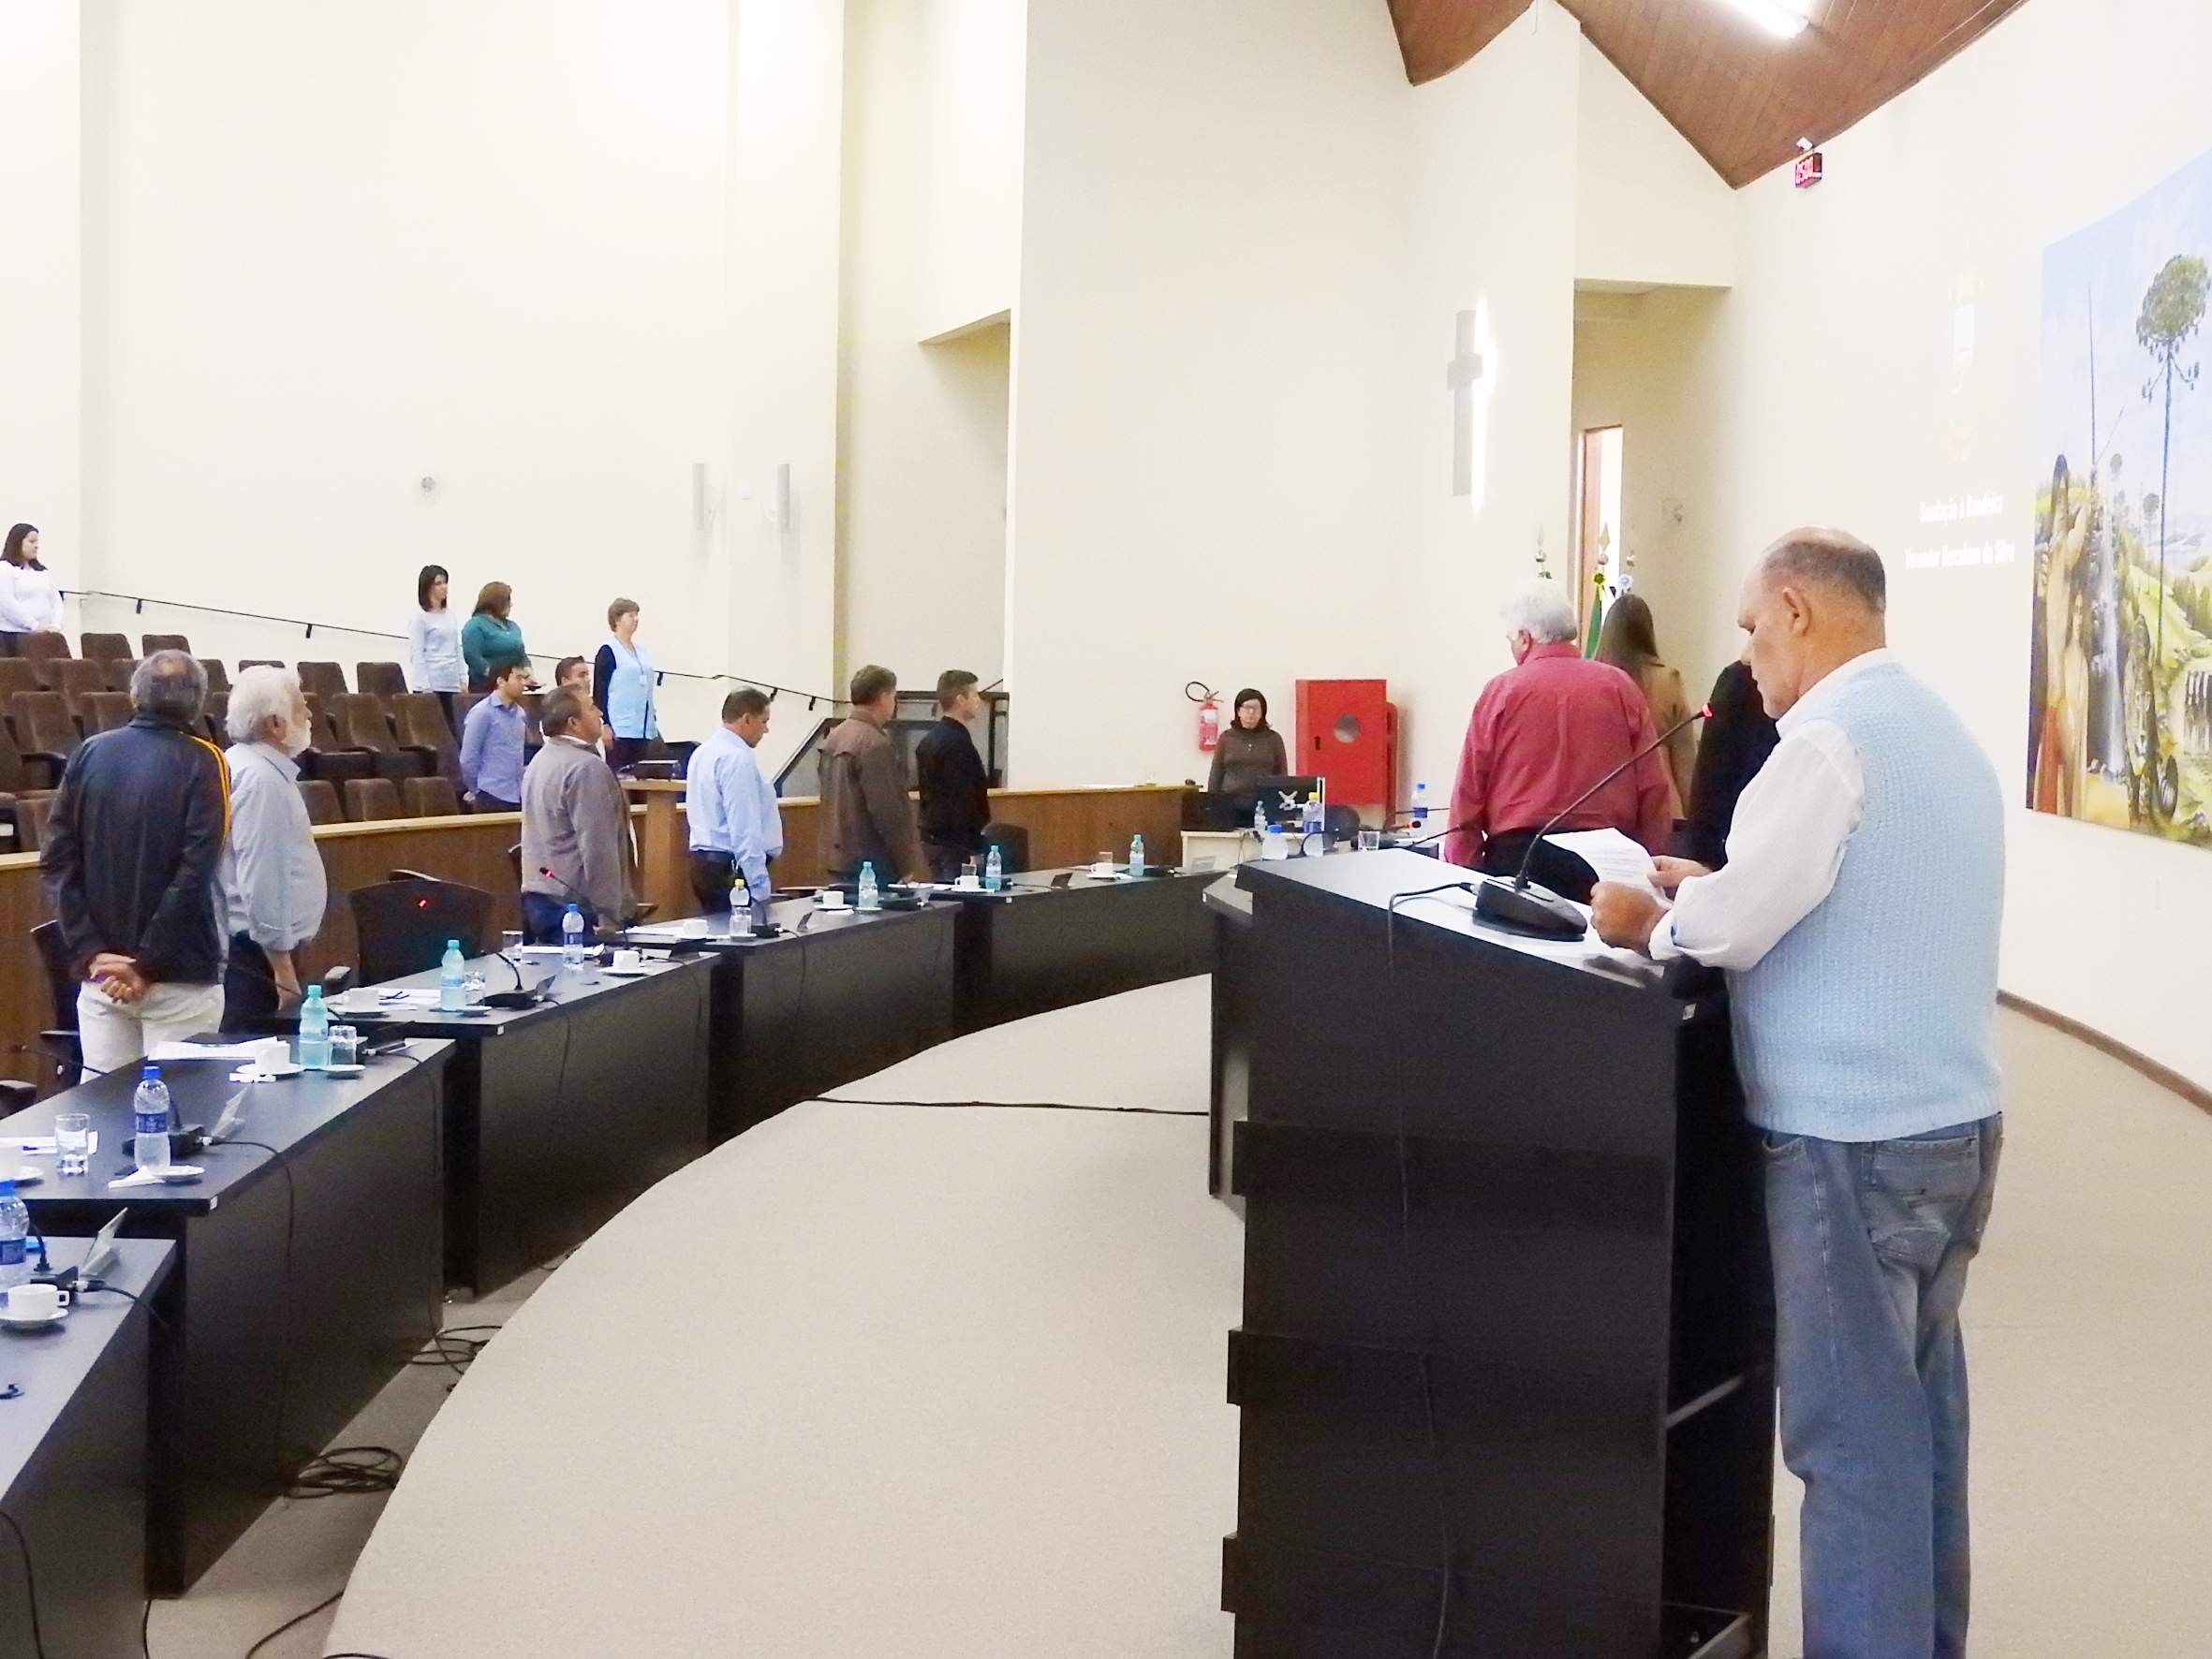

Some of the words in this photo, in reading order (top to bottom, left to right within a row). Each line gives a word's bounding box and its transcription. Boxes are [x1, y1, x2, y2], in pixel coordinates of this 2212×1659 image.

[1920, 498, 1958, 525] Saudação
[1967, 492, 2002, 518] Bandeira
[1905, 546, 1940, 569] Vereador
[1941, 543, 1981, 566] Herculano
[1983, 541, 1993, 564] da
[1995, 538, 2014, 564] Silva
